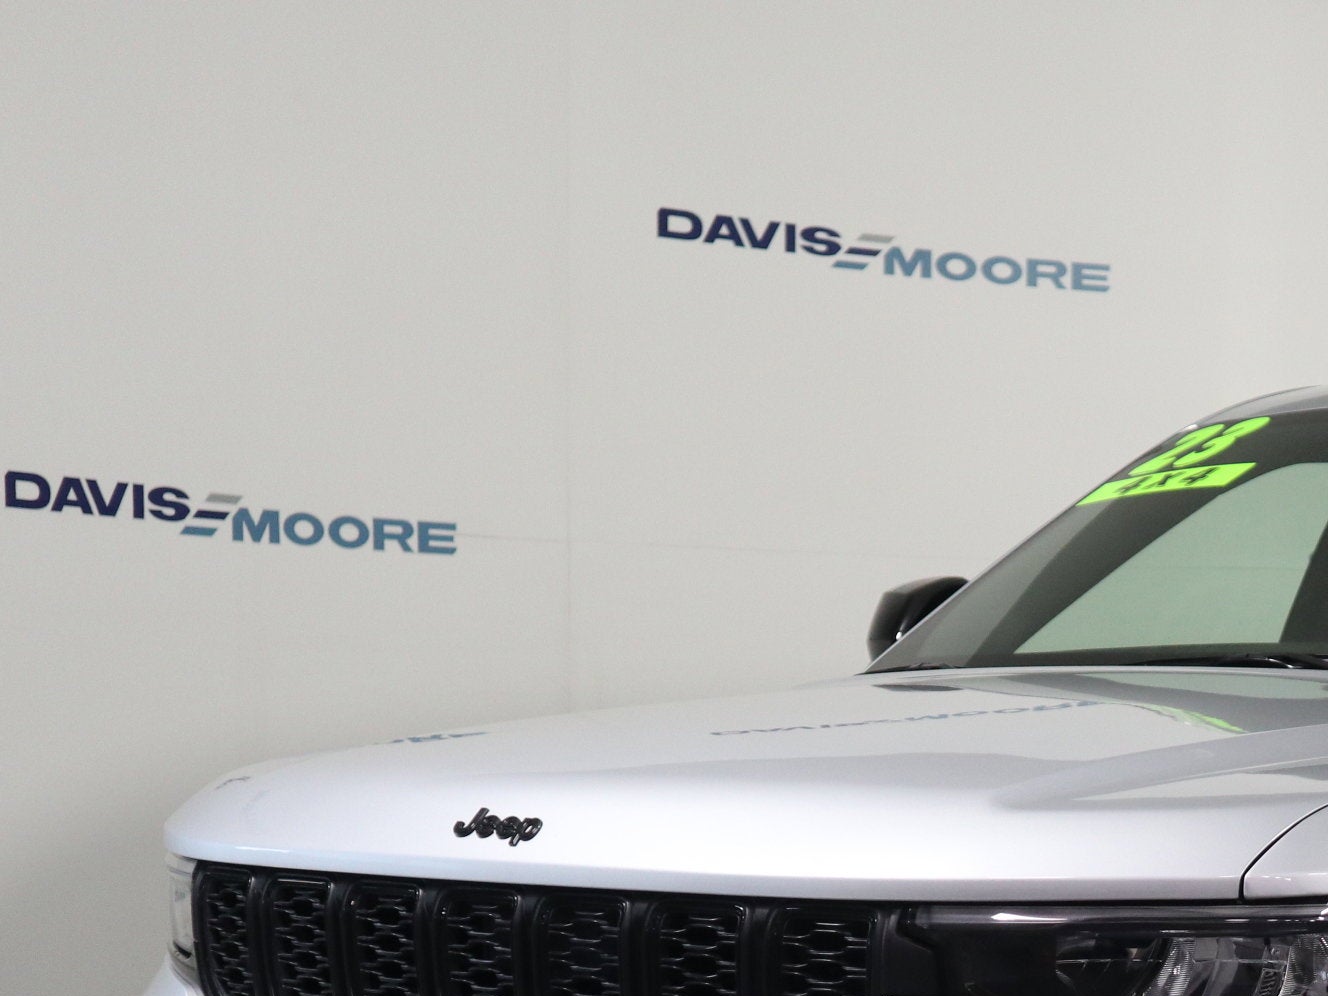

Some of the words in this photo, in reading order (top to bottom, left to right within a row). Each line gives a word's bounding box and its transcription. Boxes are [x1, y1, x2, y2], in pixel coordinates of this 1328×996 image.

[656, 206, 843, 258] DAVIS
[883, 246, 1111, 293] MOORE
[1129, 416, 1272, 476] 23
[3, 469, 192, 523] DAVIS
[231, 507, 458, 556] MOORE
[453, 807, 543, 847] Jeep
